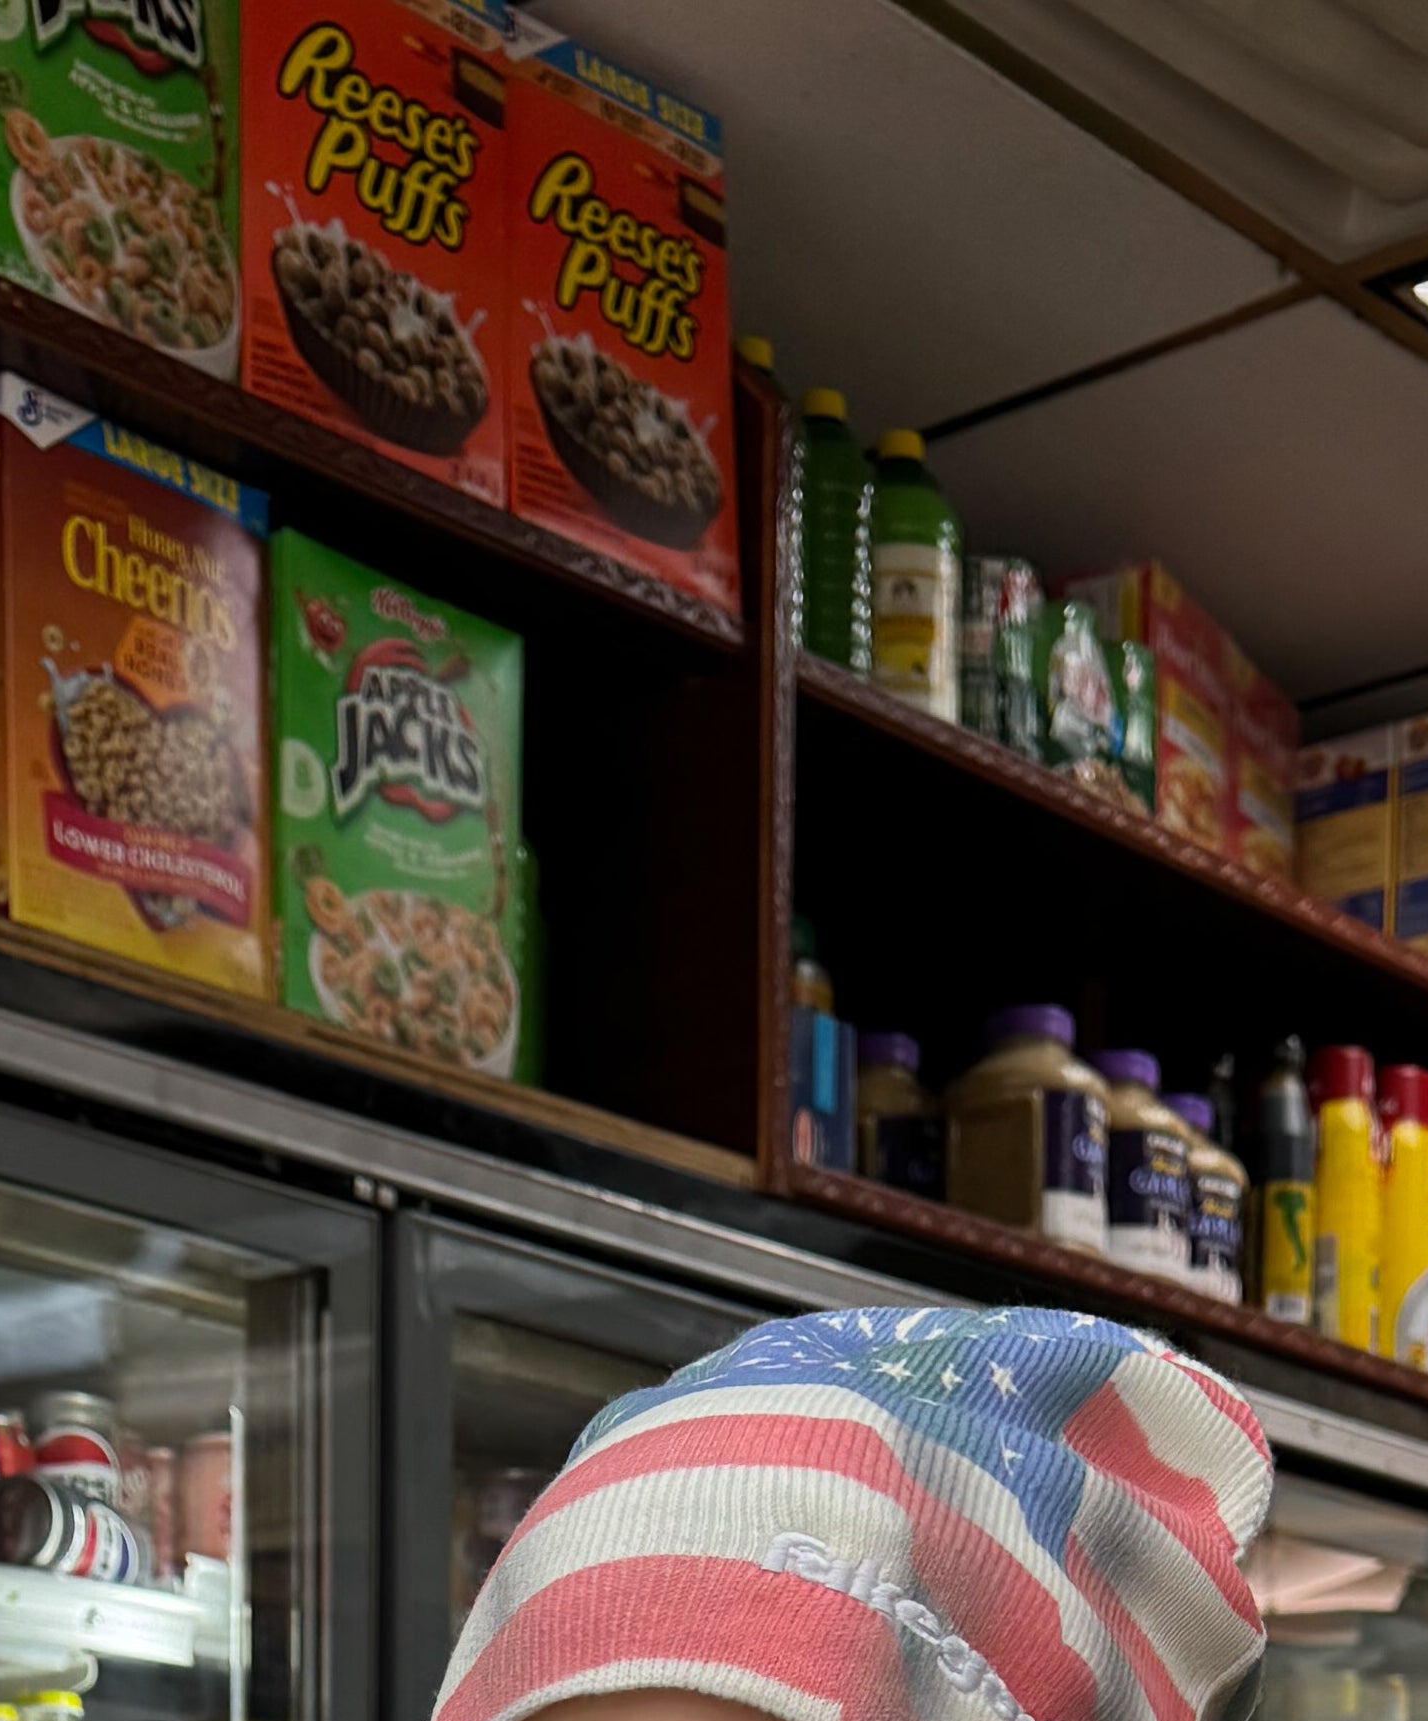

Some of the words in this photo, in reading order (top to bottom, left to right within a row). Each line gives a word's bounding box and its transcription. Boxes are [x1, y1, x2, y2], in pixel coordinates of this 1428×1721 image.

[280, 25, 479, 177] Reese's
[306, 119, 467, 247] Puffs
[532, 156, 703, 293] Reese's
[557, 242, 694, 358] Puffs
[61, 513, 238, 648] Cheerios
[338, 700, 481, 800] JACKS
[52, 818, 125, 863] LOWER
